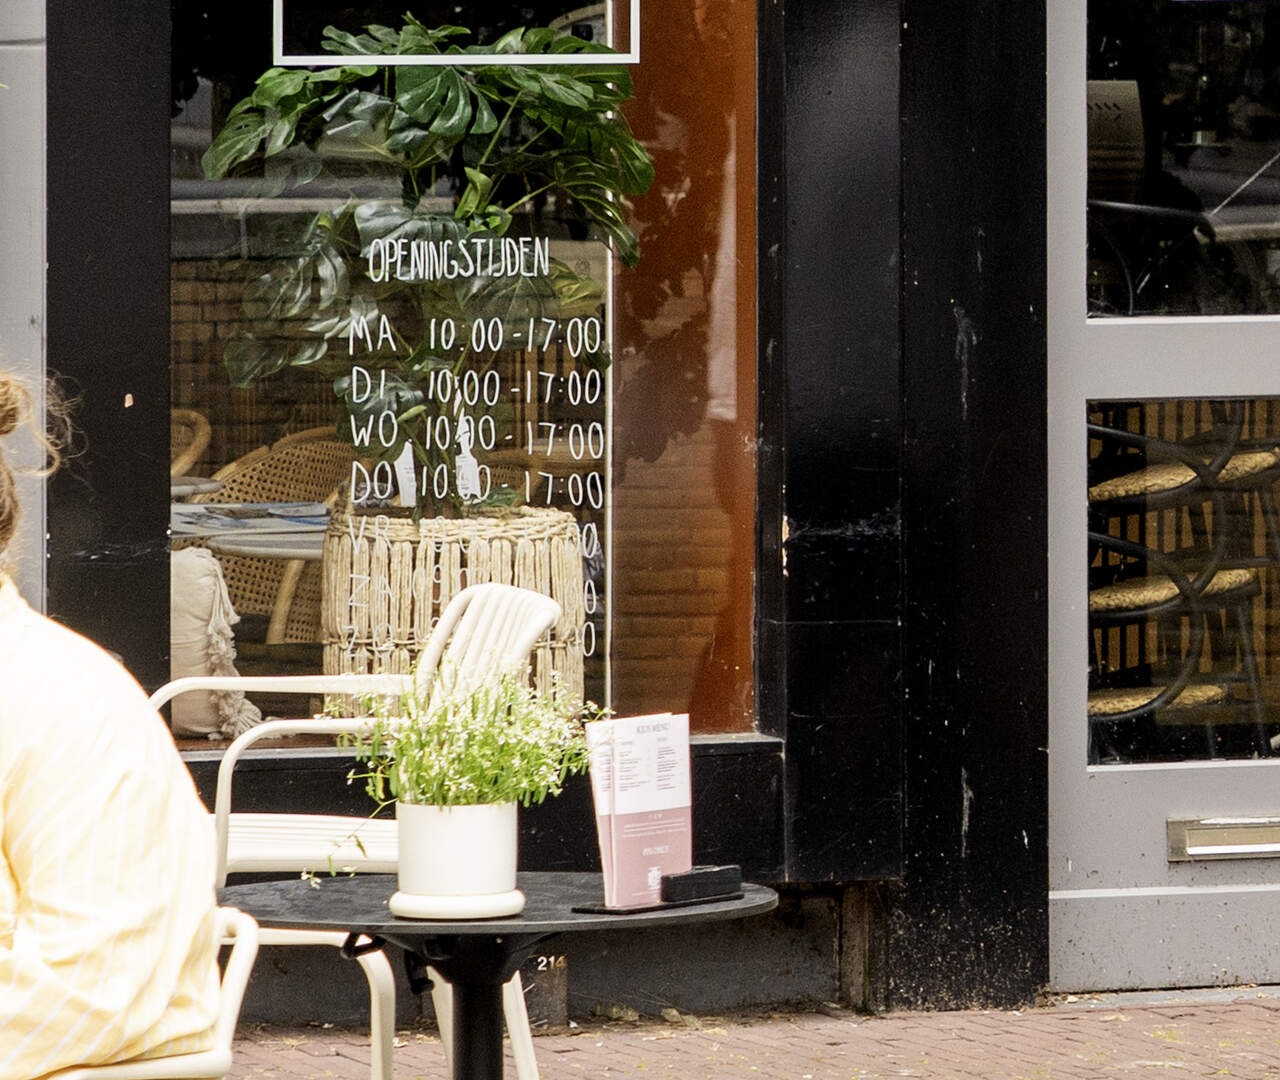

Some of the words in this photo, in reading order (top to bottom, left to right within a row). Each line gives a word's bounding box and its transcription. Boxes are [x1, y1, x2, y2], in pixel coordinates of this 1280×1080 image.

[368, 236, 550, 283] OPENINGSTIJDEN
[348, 313, 397, 356] MA
[352, 366, 386, 404] DI
[350, 410, 398, 448] WO
[351, 460, 393, 504] DO
[348, 515, 393, 555] VR
[348, 573, 395, 608] ZA
